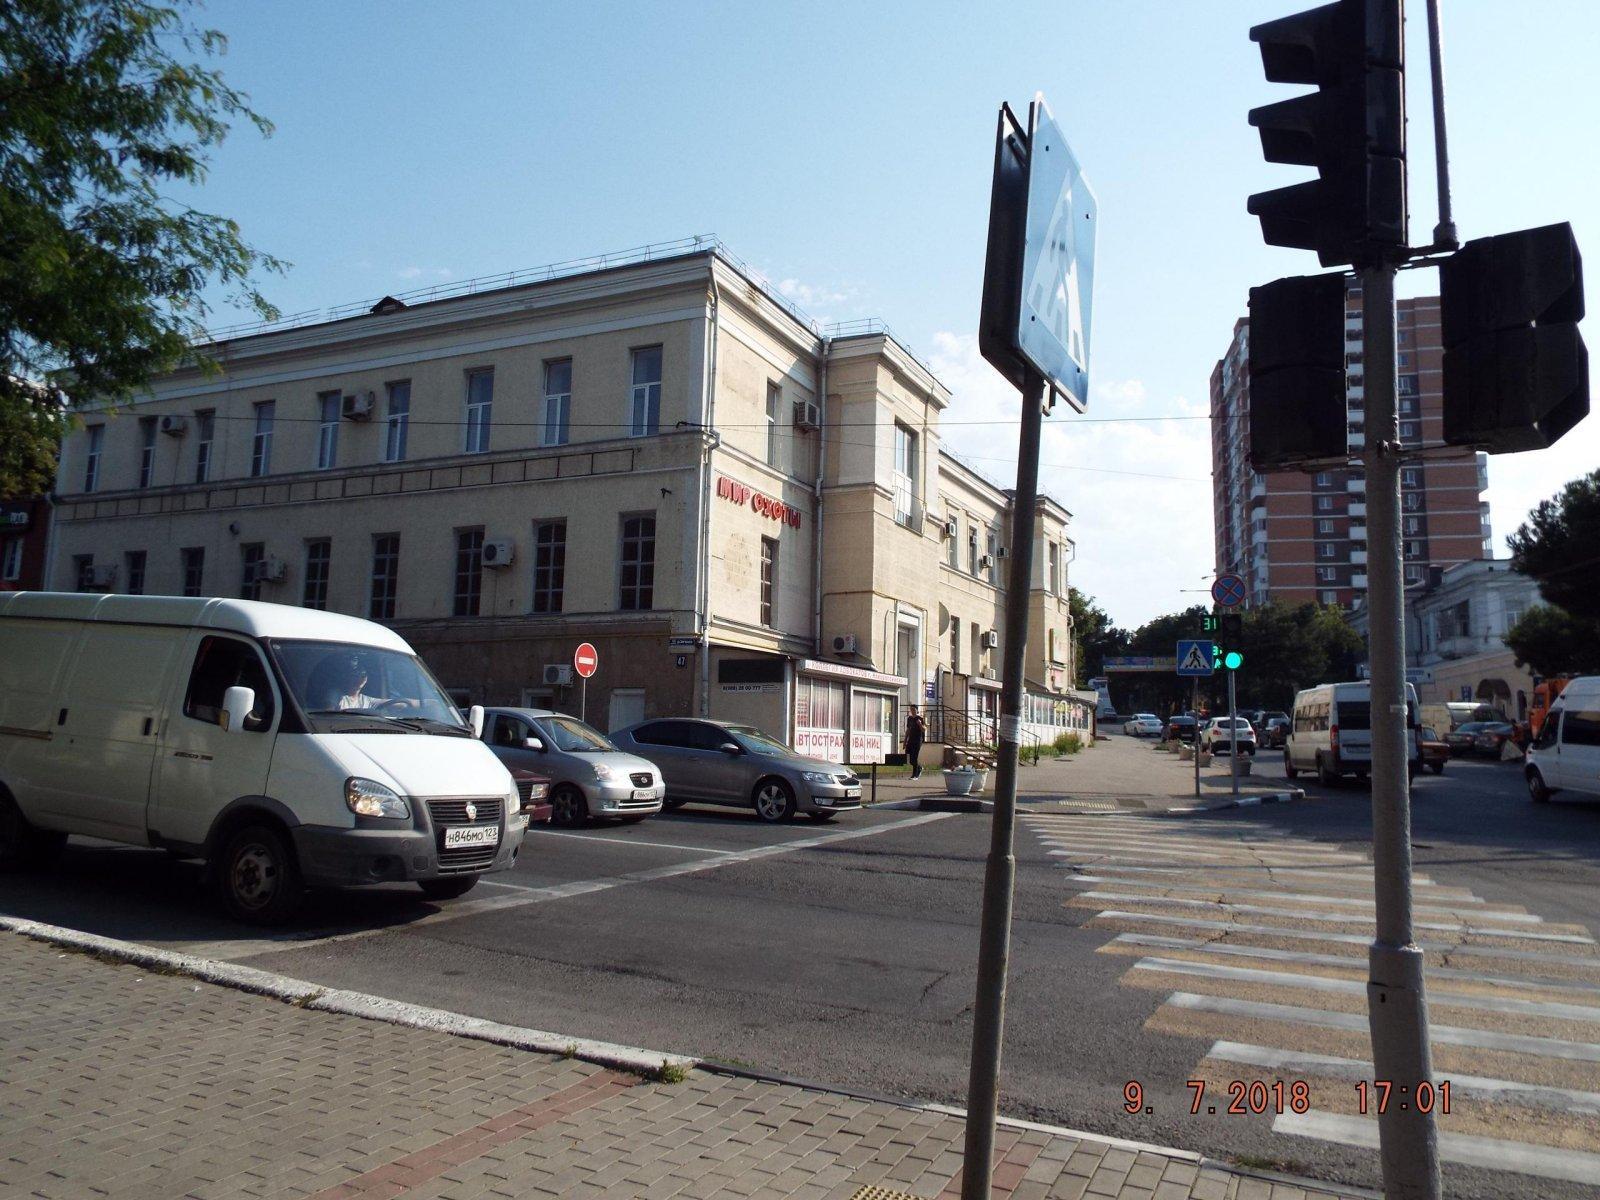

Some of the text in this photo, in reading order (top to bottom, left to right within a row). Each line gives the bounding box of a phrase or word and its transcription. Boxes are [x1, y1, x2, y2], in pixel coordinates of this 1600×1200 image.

[717, 476, 801, 529] МИР ОХОТЫ
[1204, 617, 1217, 630] 31
[448, 827, 497, 843] Н846МО 123
